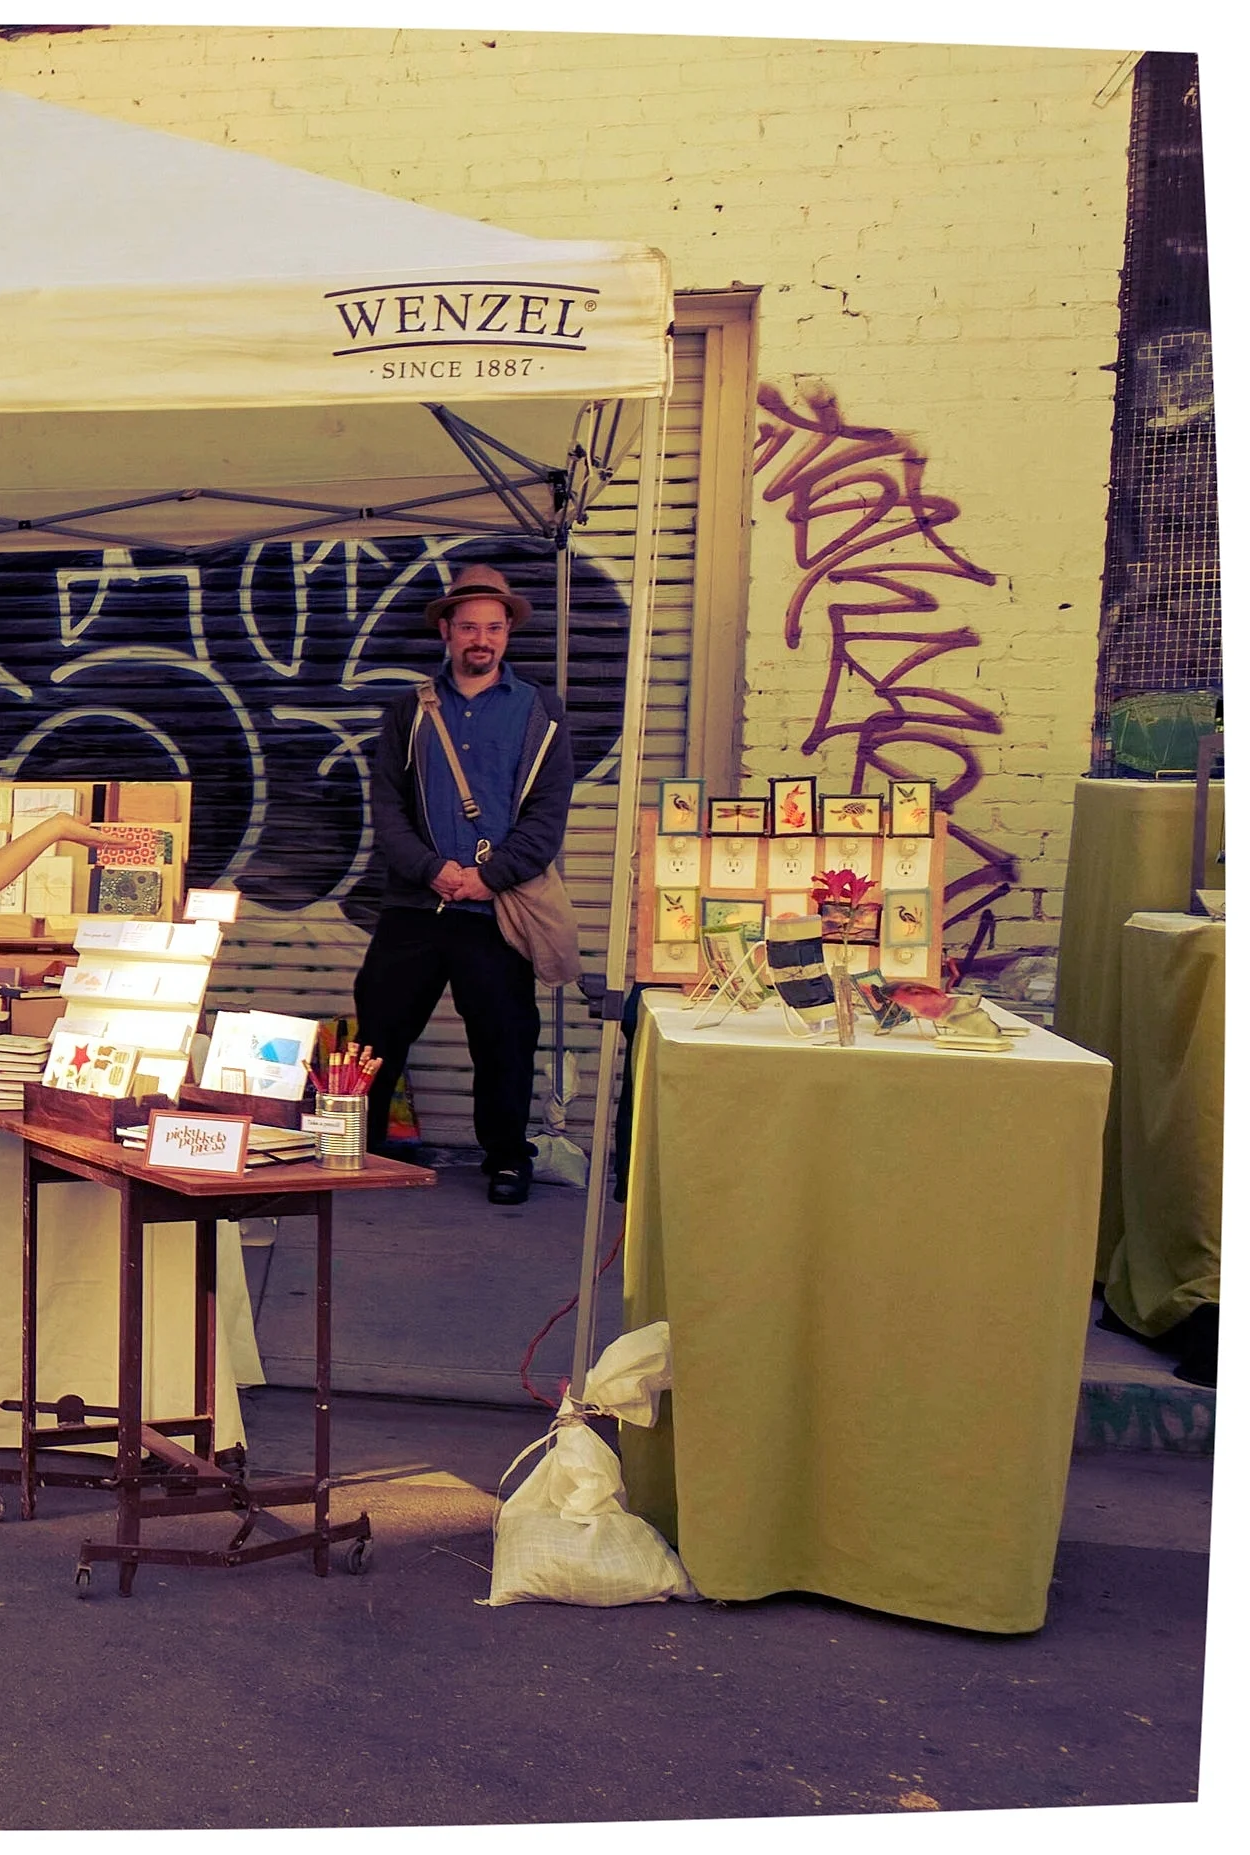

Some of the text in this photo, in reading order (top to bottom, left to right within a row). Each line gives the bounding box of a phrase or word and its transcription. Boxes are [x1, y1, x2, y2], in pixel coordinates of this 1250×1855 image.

[335, 292, 585, 341] WENZEL
[381, 357, 534, 380] SINCE 1887
